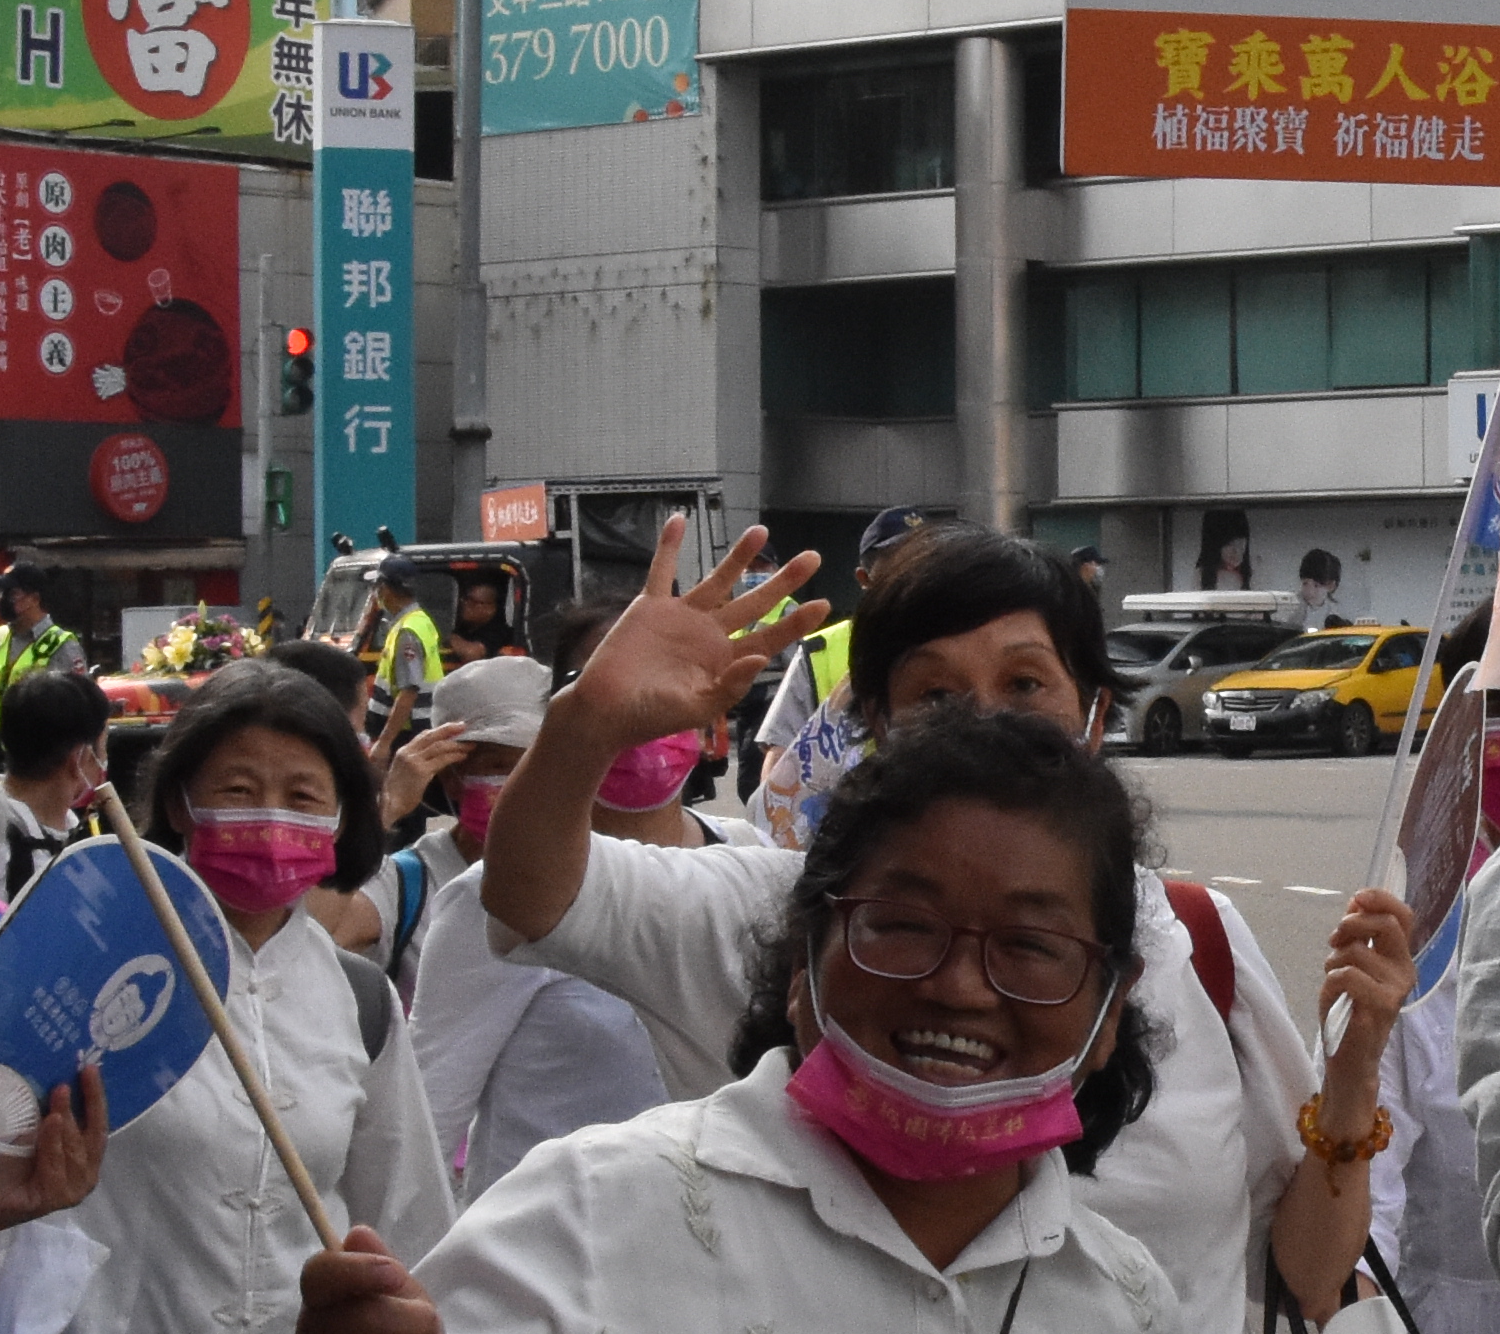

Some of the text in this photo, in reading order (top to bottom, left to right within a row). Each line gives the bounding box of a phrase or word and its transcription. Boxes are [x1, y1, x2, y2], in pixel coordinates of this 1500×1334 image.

[17, 7, 66, 88] H
[485, 15, 670, 86] 379 7000
[330, 108, 402, 121] UNION BANK
[1152, 103, 1307, 157] 植福聚寶
[1334, 110, 1485, 164] 祈福健走
[39, 172, 73, 373] 原肉主義
[341, 185, 393, 455] 聯邦銀行
